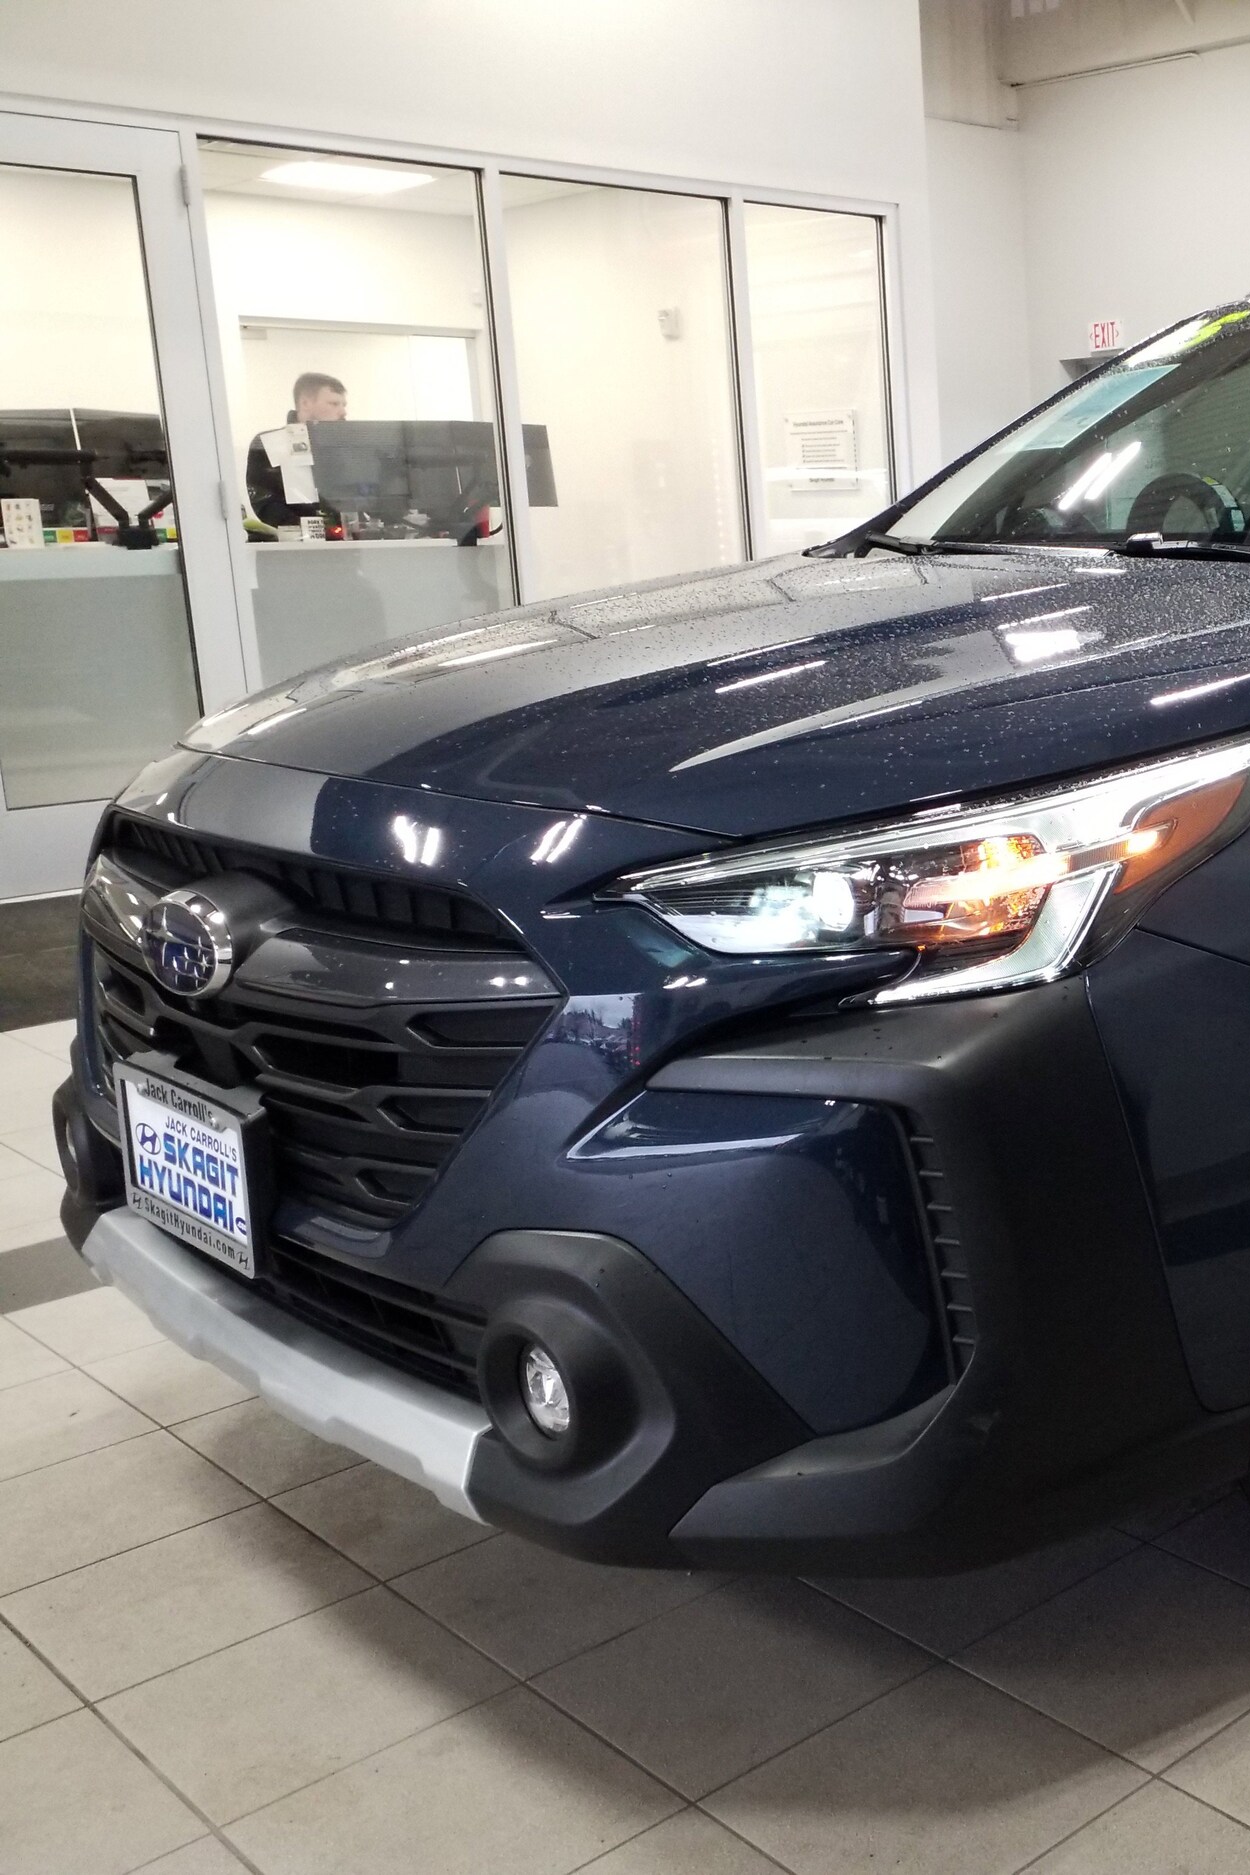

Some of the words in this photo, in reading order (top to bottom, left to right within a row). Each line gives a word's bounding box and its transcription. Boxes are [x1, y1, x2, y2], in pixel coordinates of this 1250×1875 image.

[1094, 322, 1115, 348] EXIT
[144, 1078, 168, 1104] Jack
[171, 1089, 214, 1124] Carroll's
[163, 1133, 239, 1197] SKAGIT
[165, 1116, 188, 1137] JACK
[190, 1130, 238, 1162] CARROLL'S
[139, 1154, 234, 1235] HYUNDAI
[144, 1197, 236, 1260] SkagitHyundai.com
